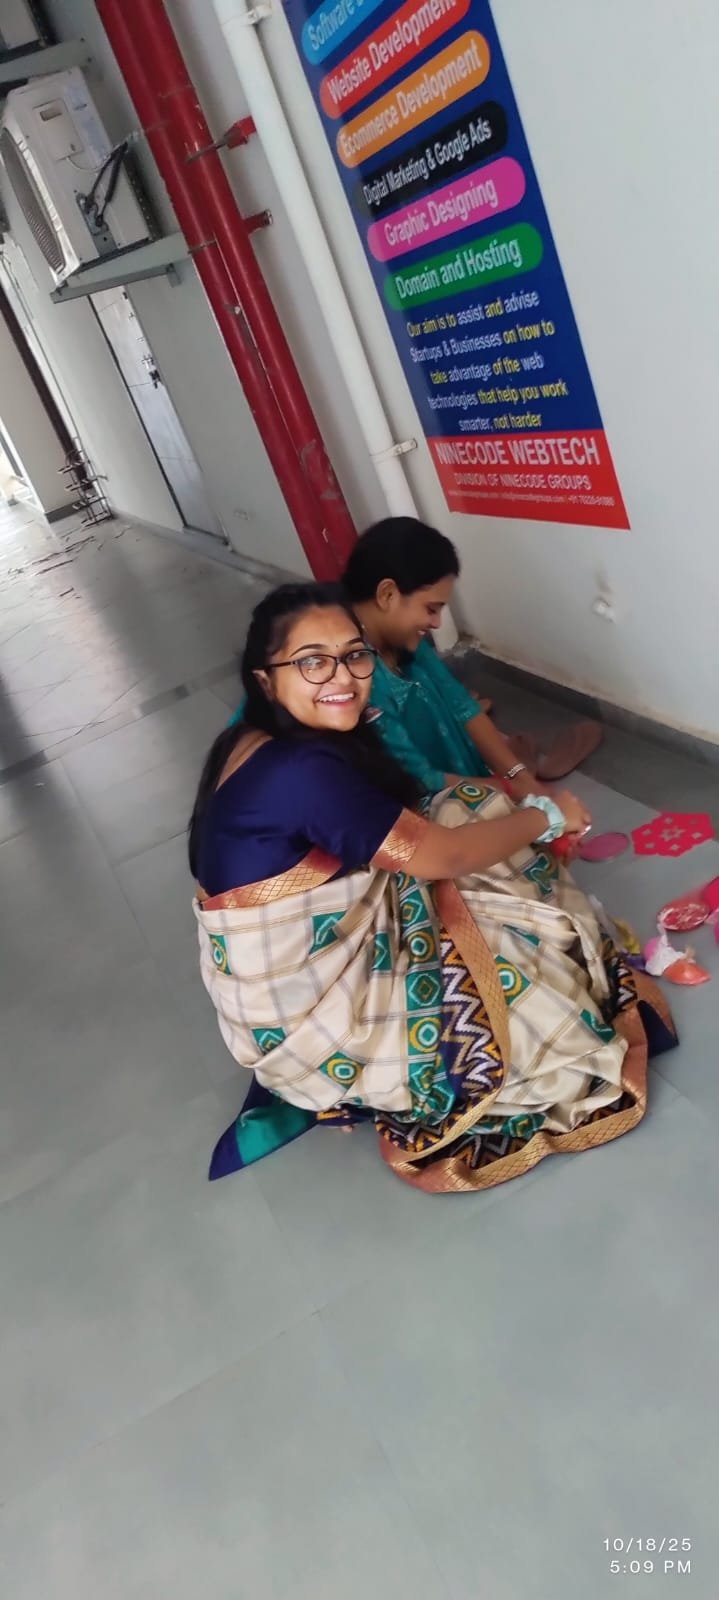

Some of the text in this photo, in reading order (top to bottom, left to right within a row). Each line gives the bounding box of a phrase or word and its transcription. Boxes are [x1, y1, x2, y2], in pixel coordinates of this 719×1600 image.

[308, 0, 355, 50] Software
[327, 0, 456, 105] Website Developmen
[341, 40, 482, 157] Ecommerce Development
[363, 117, 492, 206] Digital Marketing & Google Ads
[384, 177, 498, 246] Graphic Designing
[395, 238, 522, 299] Domain and Hosting
[406, 291, 540, 337] Our aim is to assist and advise
[410, 321, 555, 363] Startups & Businesses on how to
[430, 353, 544, 384] take advantage of the web
[428, 380, 568, 411] technologies that help you work
[459, 412, 542, 432] smarter, not harder
[436, 438, 600, 466] NINECODE WEBTECH
[455, 473, 592, 490] DIVISION OF NINECODE GROUPS
